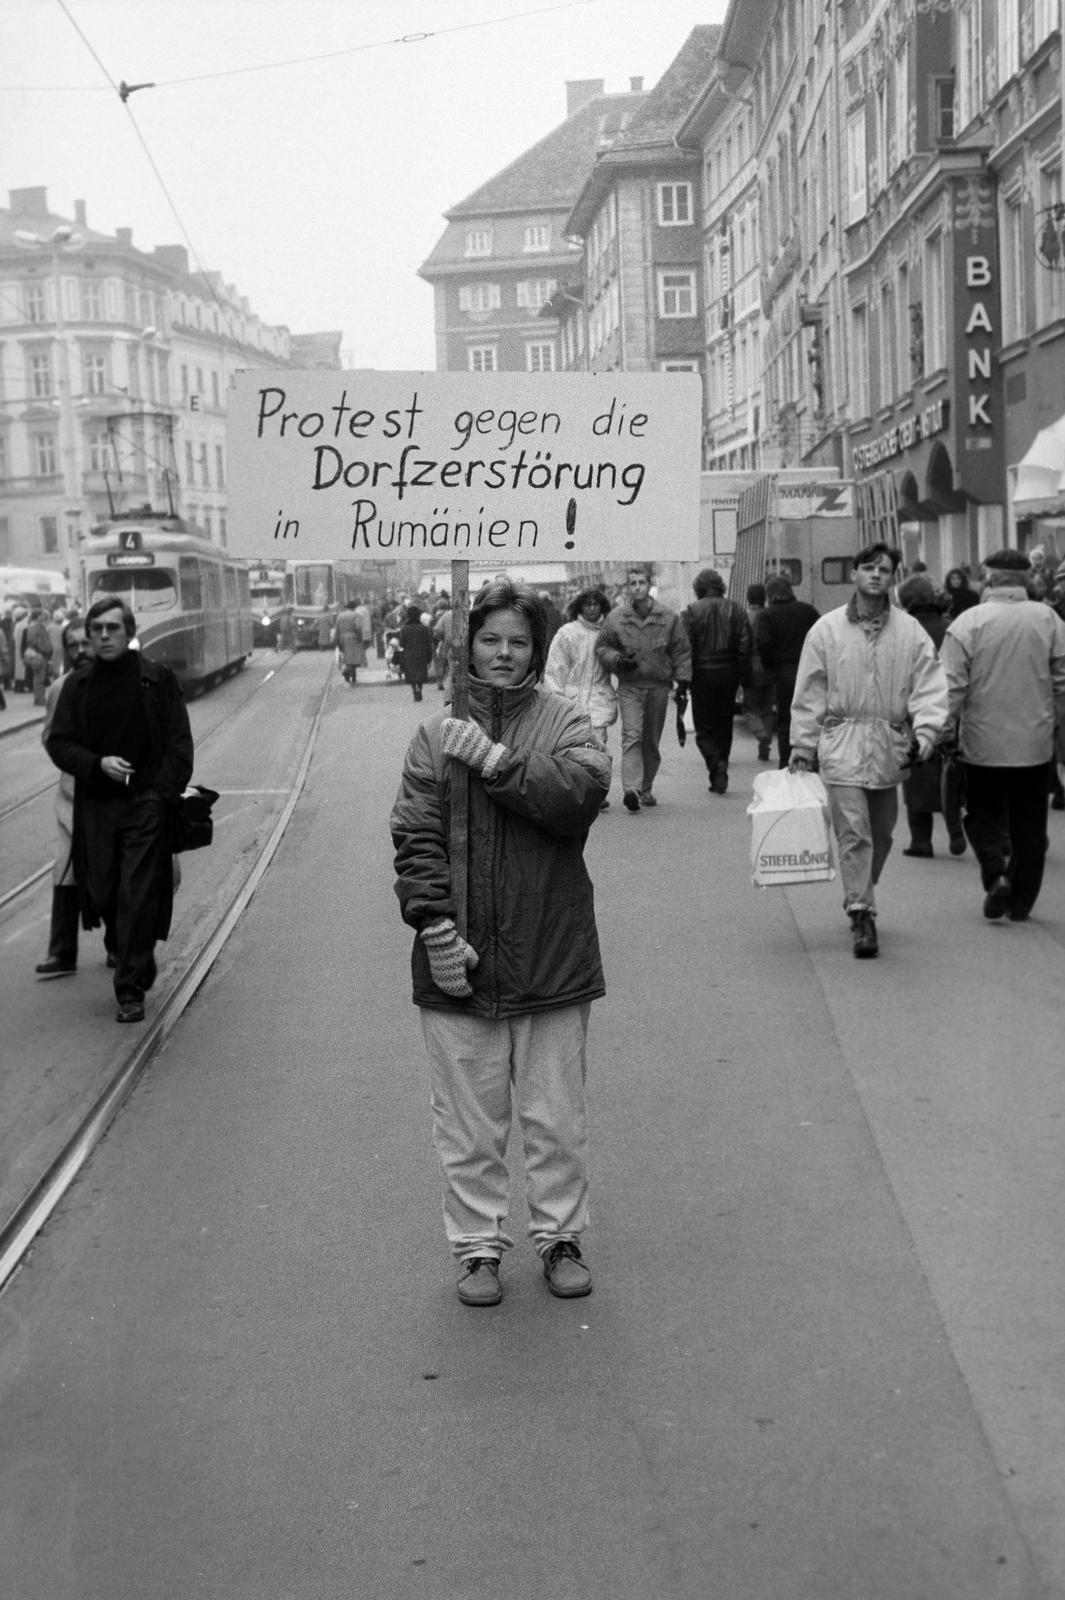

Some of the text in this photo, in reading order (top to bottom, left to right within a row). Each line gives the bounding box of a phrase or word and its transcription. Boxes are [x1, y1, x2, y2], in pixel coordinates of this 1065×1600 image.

[966, 256, 993, 425] BANK
[257, 387, 648, 450] Protest gegen die
[311, 445, 646, 506] Dorfzerstörung
[126, 533, 135, 549] 4
[274, 510, 300, 539] in
[351, 499, 538, 550] Rumänien
